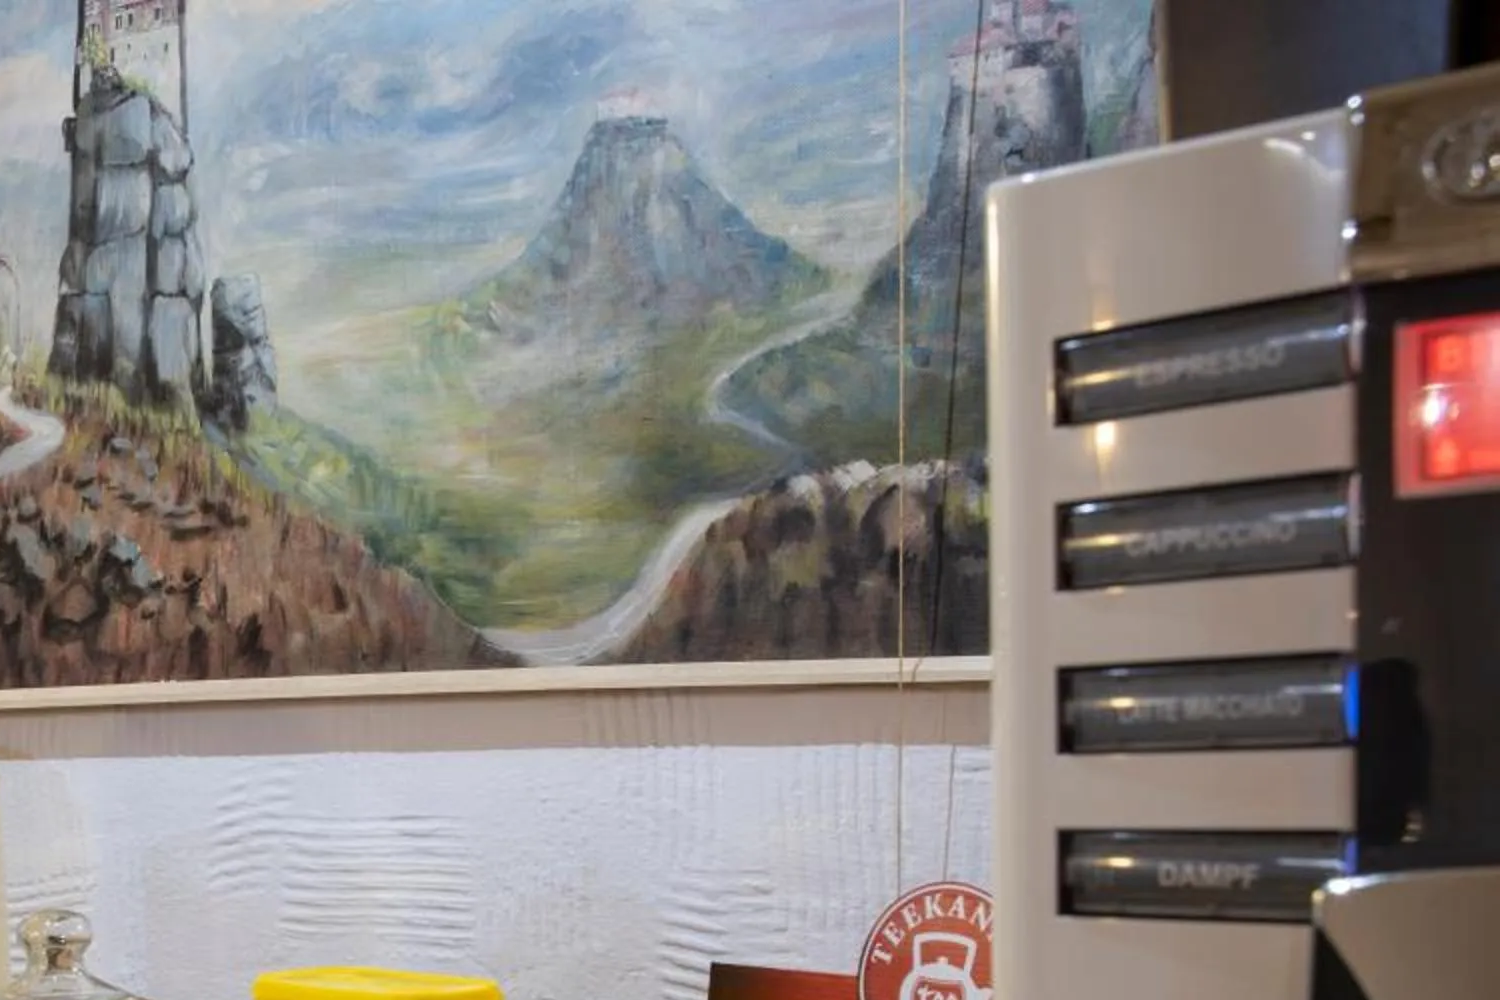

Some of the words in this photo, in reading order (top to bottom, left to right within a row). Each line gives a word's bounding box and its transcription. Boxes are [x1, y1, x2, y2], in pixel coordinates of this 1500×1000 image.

[1134, 343, 1286, 388] ESPRESSO
[1124, 520, 1298, 557] CAPPUCCINO
[1157, 860, 1260, 889] DAMPF
[870, 892, 994, 966] TEEKAN
